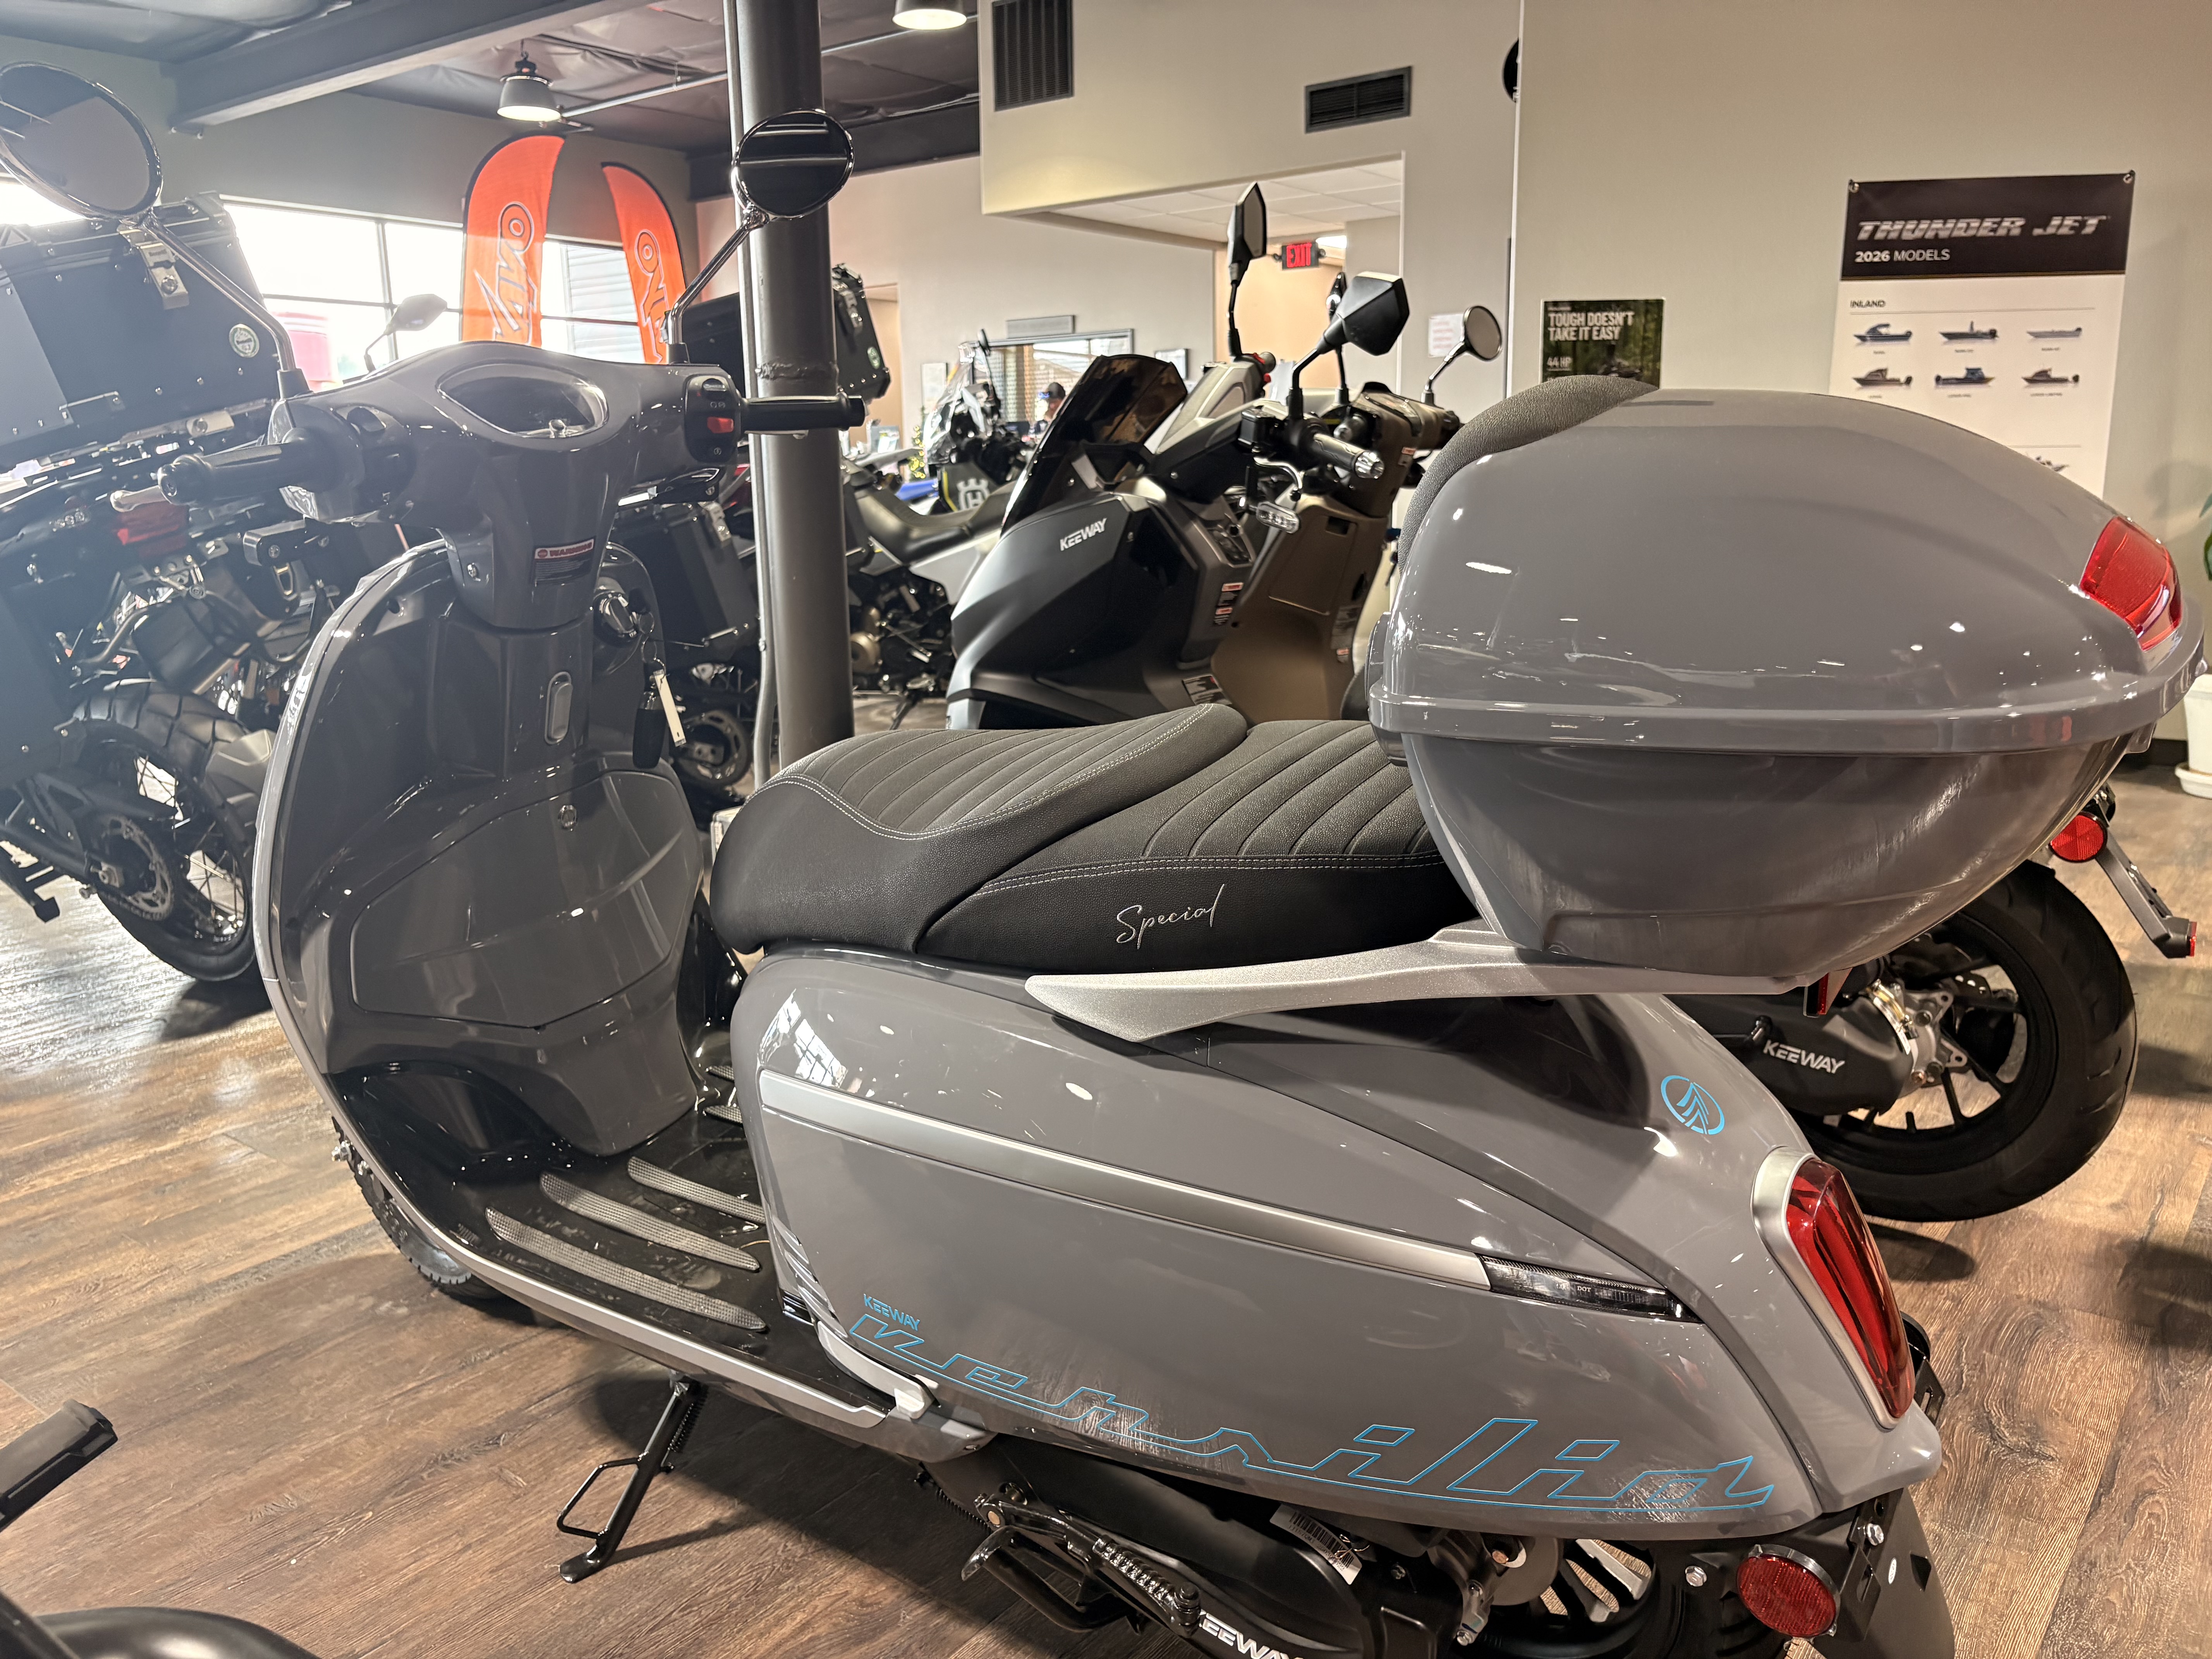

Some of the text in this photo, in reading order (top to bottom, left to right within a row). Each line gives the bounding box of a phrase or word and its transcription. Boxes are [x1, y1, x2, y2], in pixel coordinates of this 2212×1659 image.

[1857, 215, 2107, 240] THUNDER JET
[1286, 242, 1312, 268] EXIT
[1855, 249, 1950, 263] 2026 MODELS
[1850, 299, 1886, 308] INLAND
[1548, 311, 1635, 327] TOUGH DOESN'T
[1548, 326, 1621, 341] TAKE IT EASY
[1547, 356, 1572, 368] 44 HP
[1060, 518, 1107, 551] KEEWAY
[1116, 884, 1225, 950] Special
[1763, 1039, 1845, 1074] KEEWAY
[863, 1293, 921, 1331] KEEWAY
[1200, 1609, 1304, 1659] EEWA
